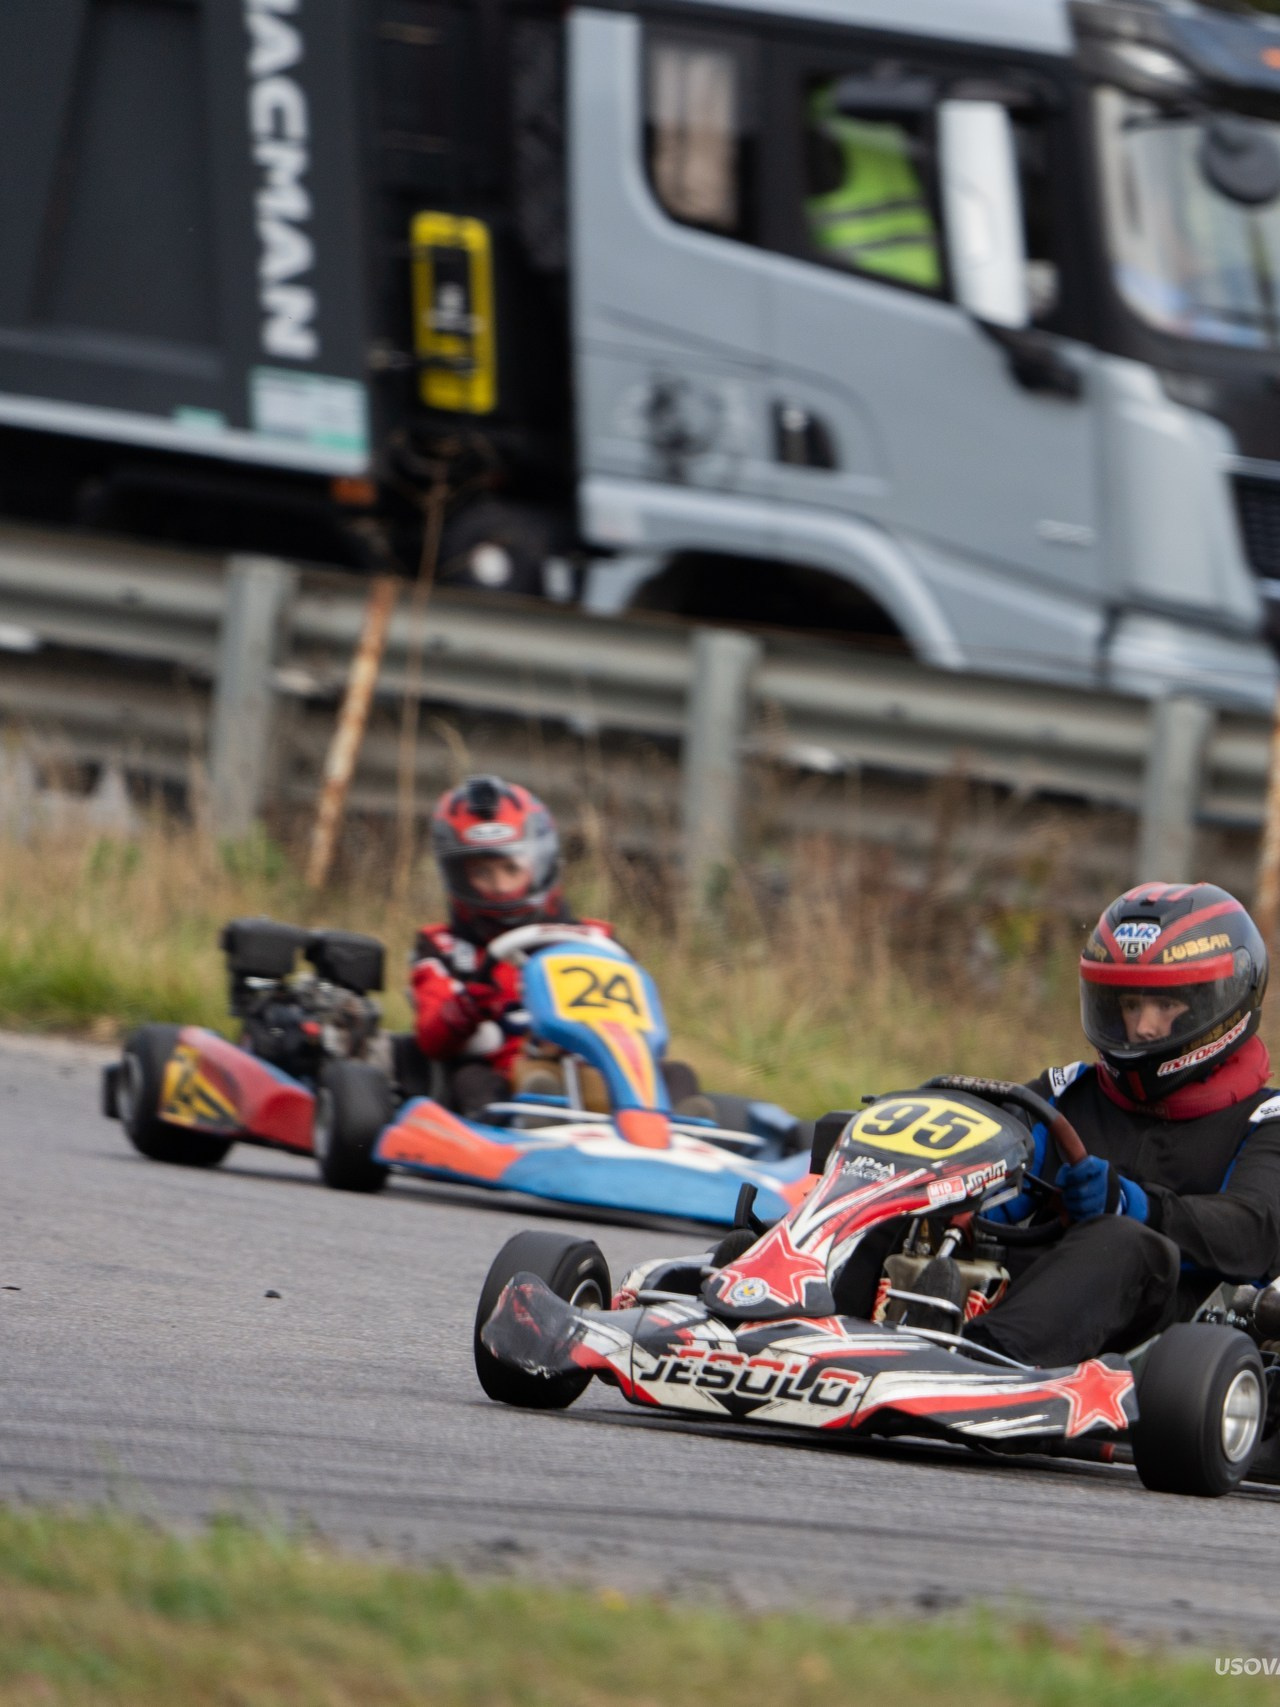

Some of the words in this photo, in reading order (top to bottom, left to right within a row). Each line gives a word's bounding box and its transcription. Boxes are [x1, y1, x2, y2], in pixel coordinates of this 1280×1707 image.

[244, 0, 320, 360] ACMAN
[560, 965, 640, 1016] 24
[861, 1104, 983, 1150] 95
[638, 1347, 860, 1408] JESOLO
